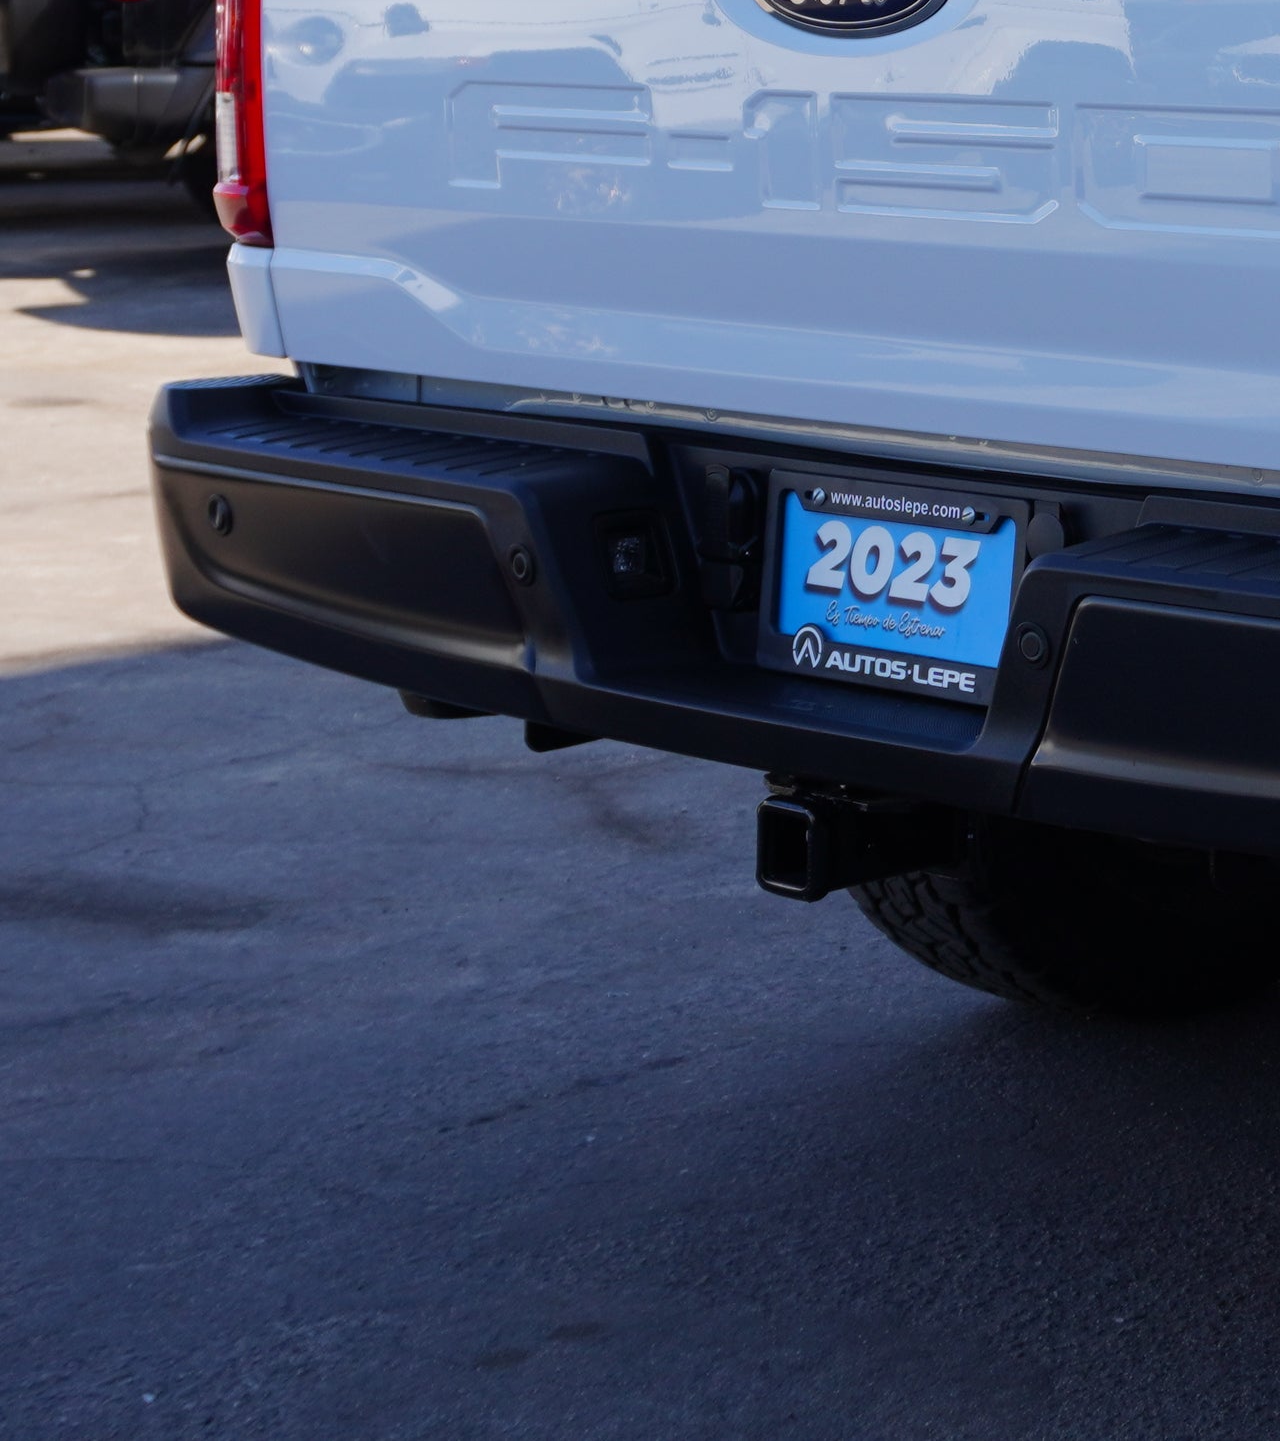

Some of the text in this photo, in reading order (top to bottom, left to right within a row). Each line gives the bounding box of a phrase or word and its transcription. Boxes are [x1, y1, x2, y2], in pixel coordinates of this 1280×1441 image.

[830, 490, 961, 519] www.autoslepe.com
[806, 520, 981, 608] 2023
[826, 599, 946, 637] Es Tiempo de Estrenar
